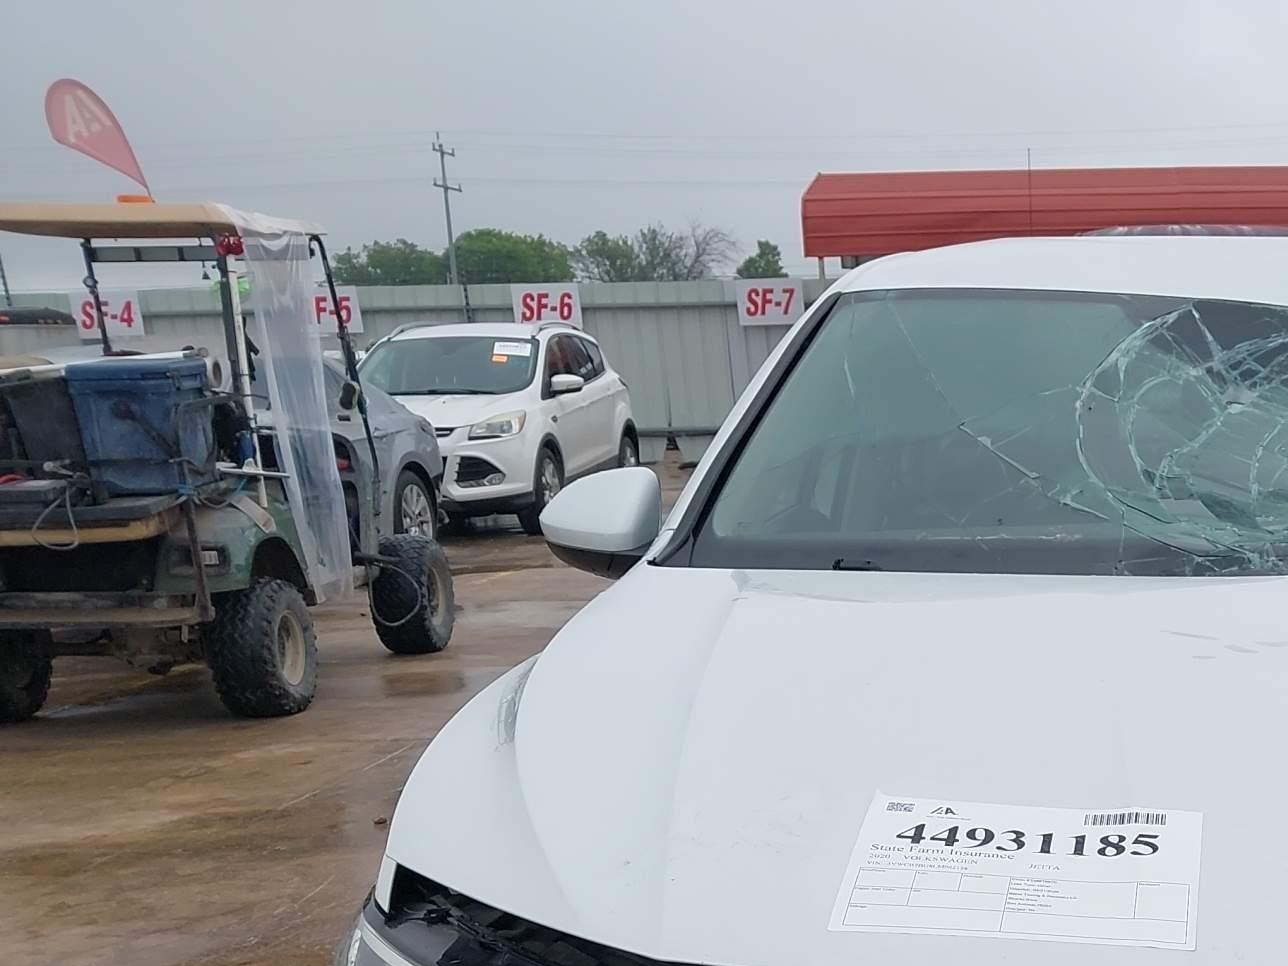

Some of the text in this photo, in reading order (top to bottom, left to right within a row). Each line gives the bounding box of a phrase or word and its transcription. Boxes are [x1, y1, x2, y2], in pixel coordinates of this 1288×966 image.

[315, 296, 351, 325] F-5
[521, 292, 573, 322] SF-6
[746, 287, 796, 317] SF-7
[870, 843, 1015, 860] State Farm Insurance
[895, 823, 1160, 857] 44931185
[904, 854, 978, 865] VOLKSWAGEN
